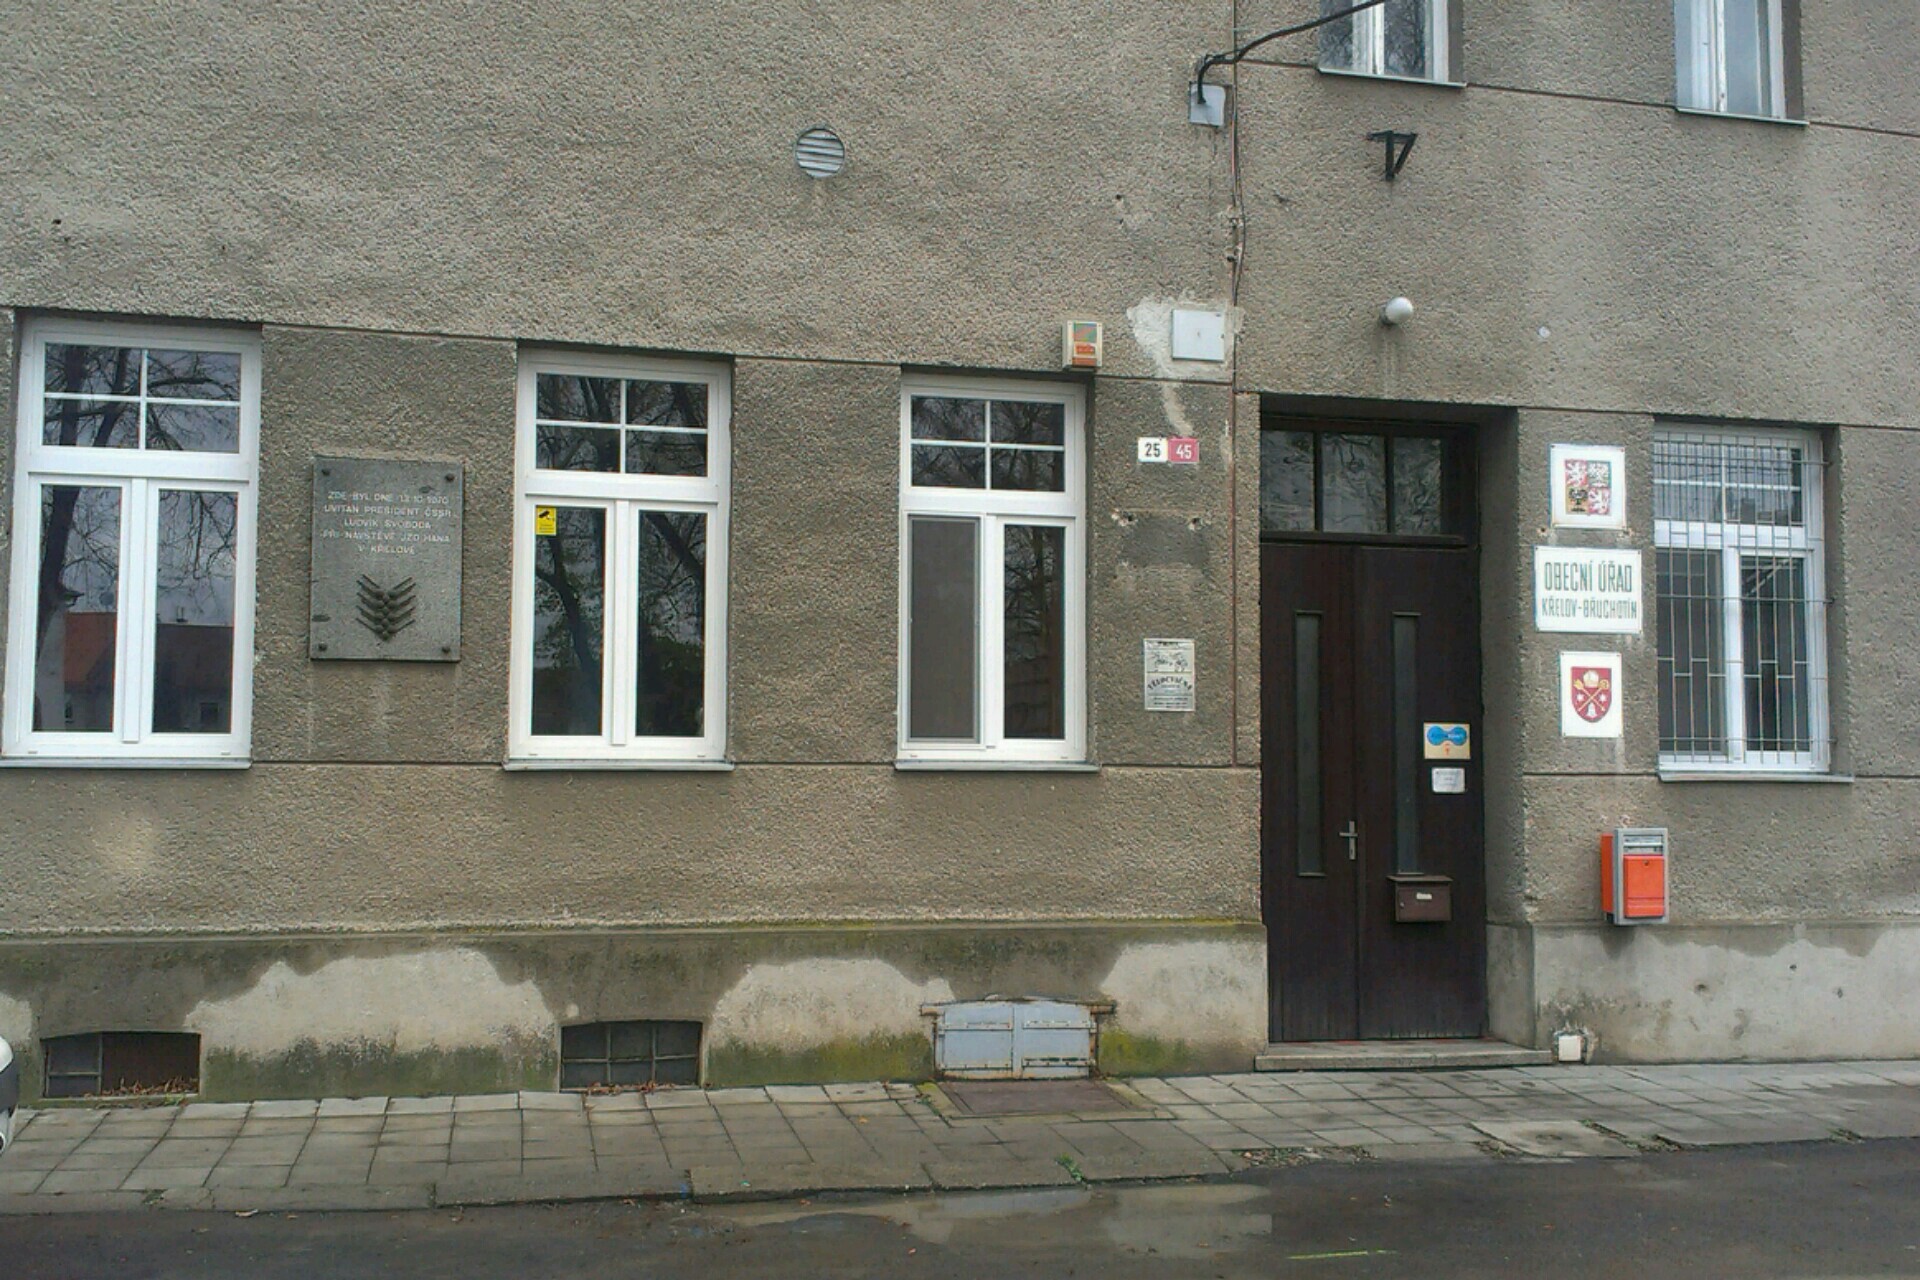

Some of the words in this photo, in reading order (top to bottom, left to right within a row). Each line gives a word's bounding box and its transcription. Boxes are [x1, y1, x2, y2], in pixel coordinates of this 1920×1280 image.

[1145, 442, 1161, 457] 25
[1176, 444, 1192, 460] 45
[1544, 560, 1593, 591] OBECNÍ
[1598, 560, 1632, 593] ÚŘAD
